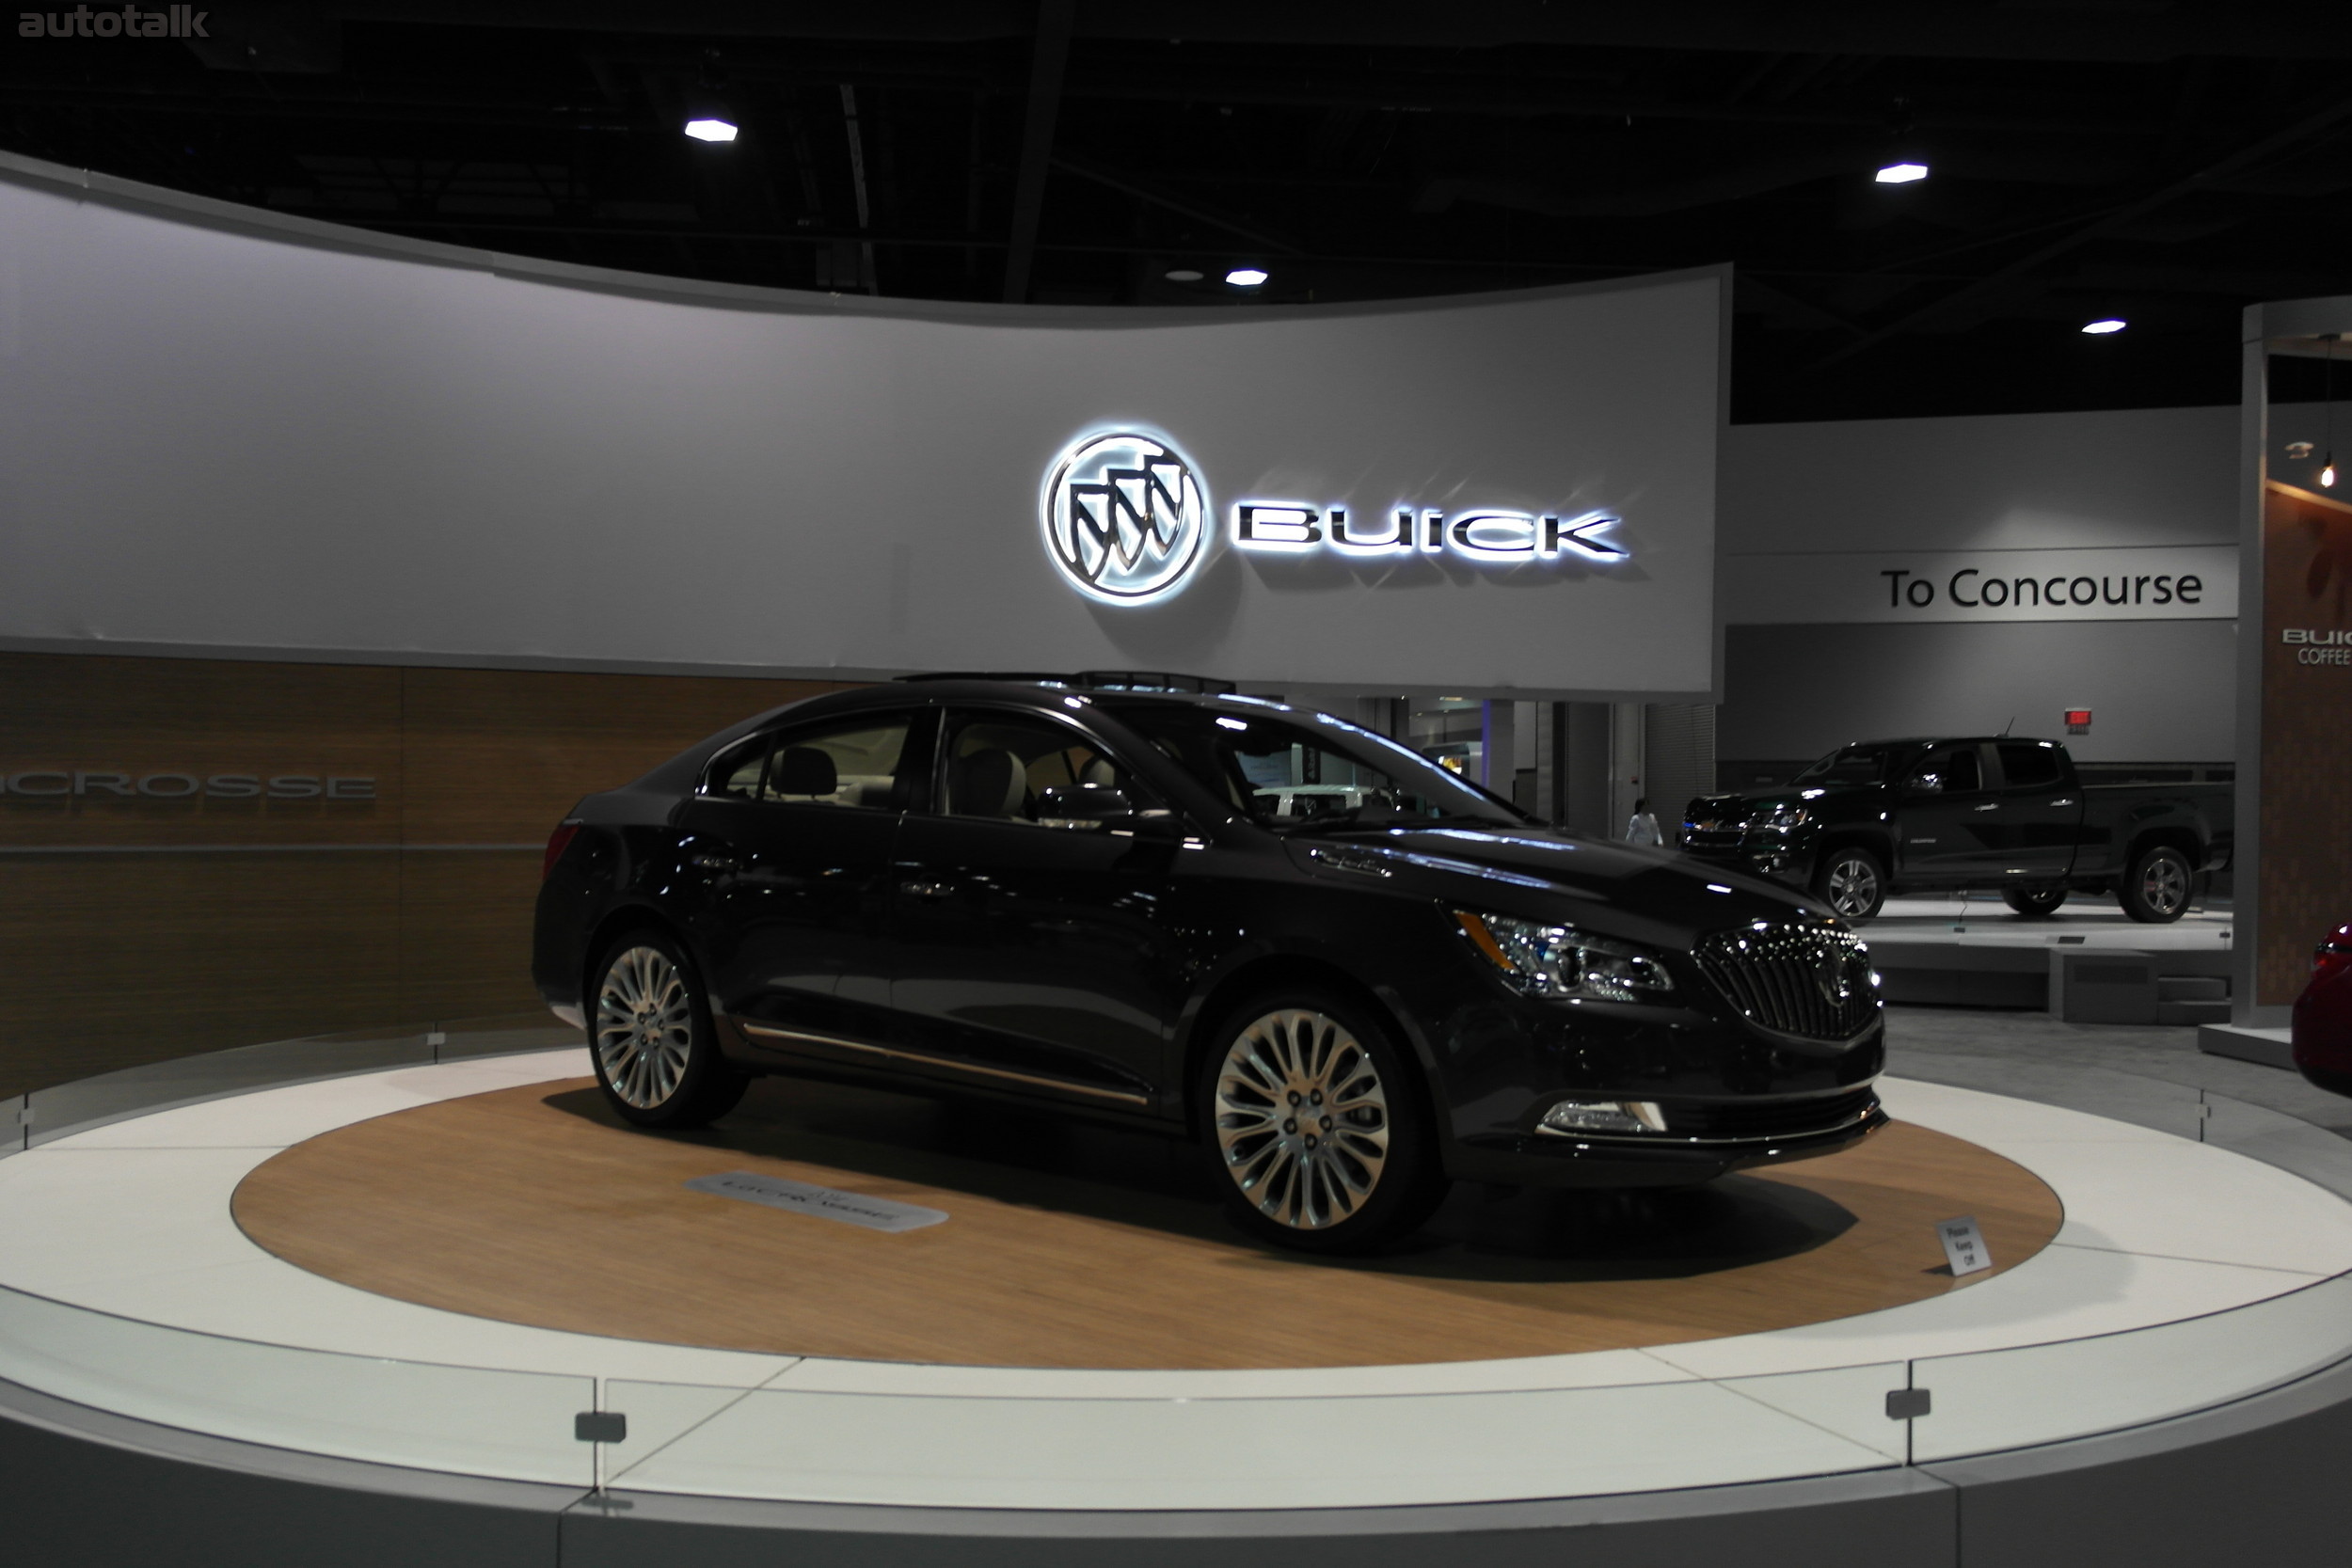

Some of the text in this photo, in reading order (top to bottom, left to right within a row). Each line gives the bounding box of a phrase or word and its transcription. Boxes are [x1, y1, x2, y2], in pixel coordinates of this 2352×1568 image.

[1232, 502, 1630, 561] BUICK
[1881, 569, 2202, 608] To Concourse
[2297, 647, 2351, 665] COFFEE
[0, 771, 376, 799] CROSSE
